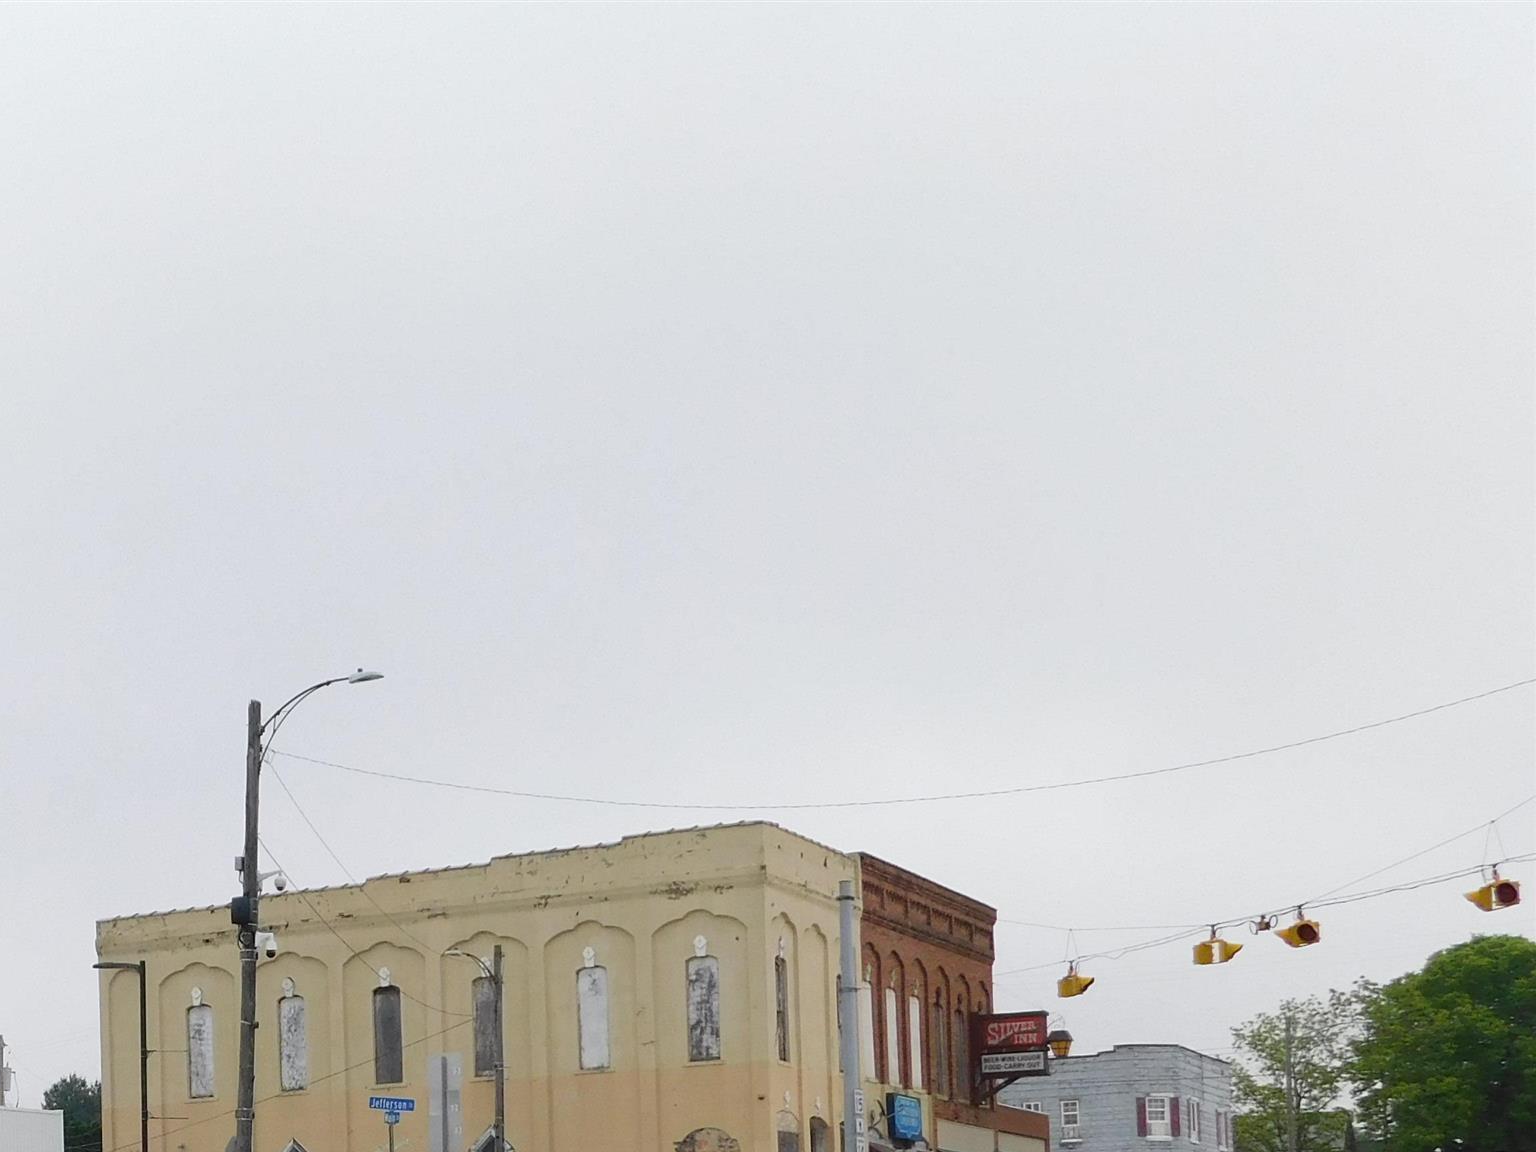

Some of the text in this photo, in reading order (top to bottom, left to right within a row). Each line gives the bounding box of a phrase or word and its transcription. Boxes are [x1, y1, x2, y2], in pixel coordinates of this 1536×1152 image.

[987, 1021, 1037, 1045] SILVER
[1014, 1033, 1037, 1044] INN
[370, 1098, 407, 1110] Jefferson
